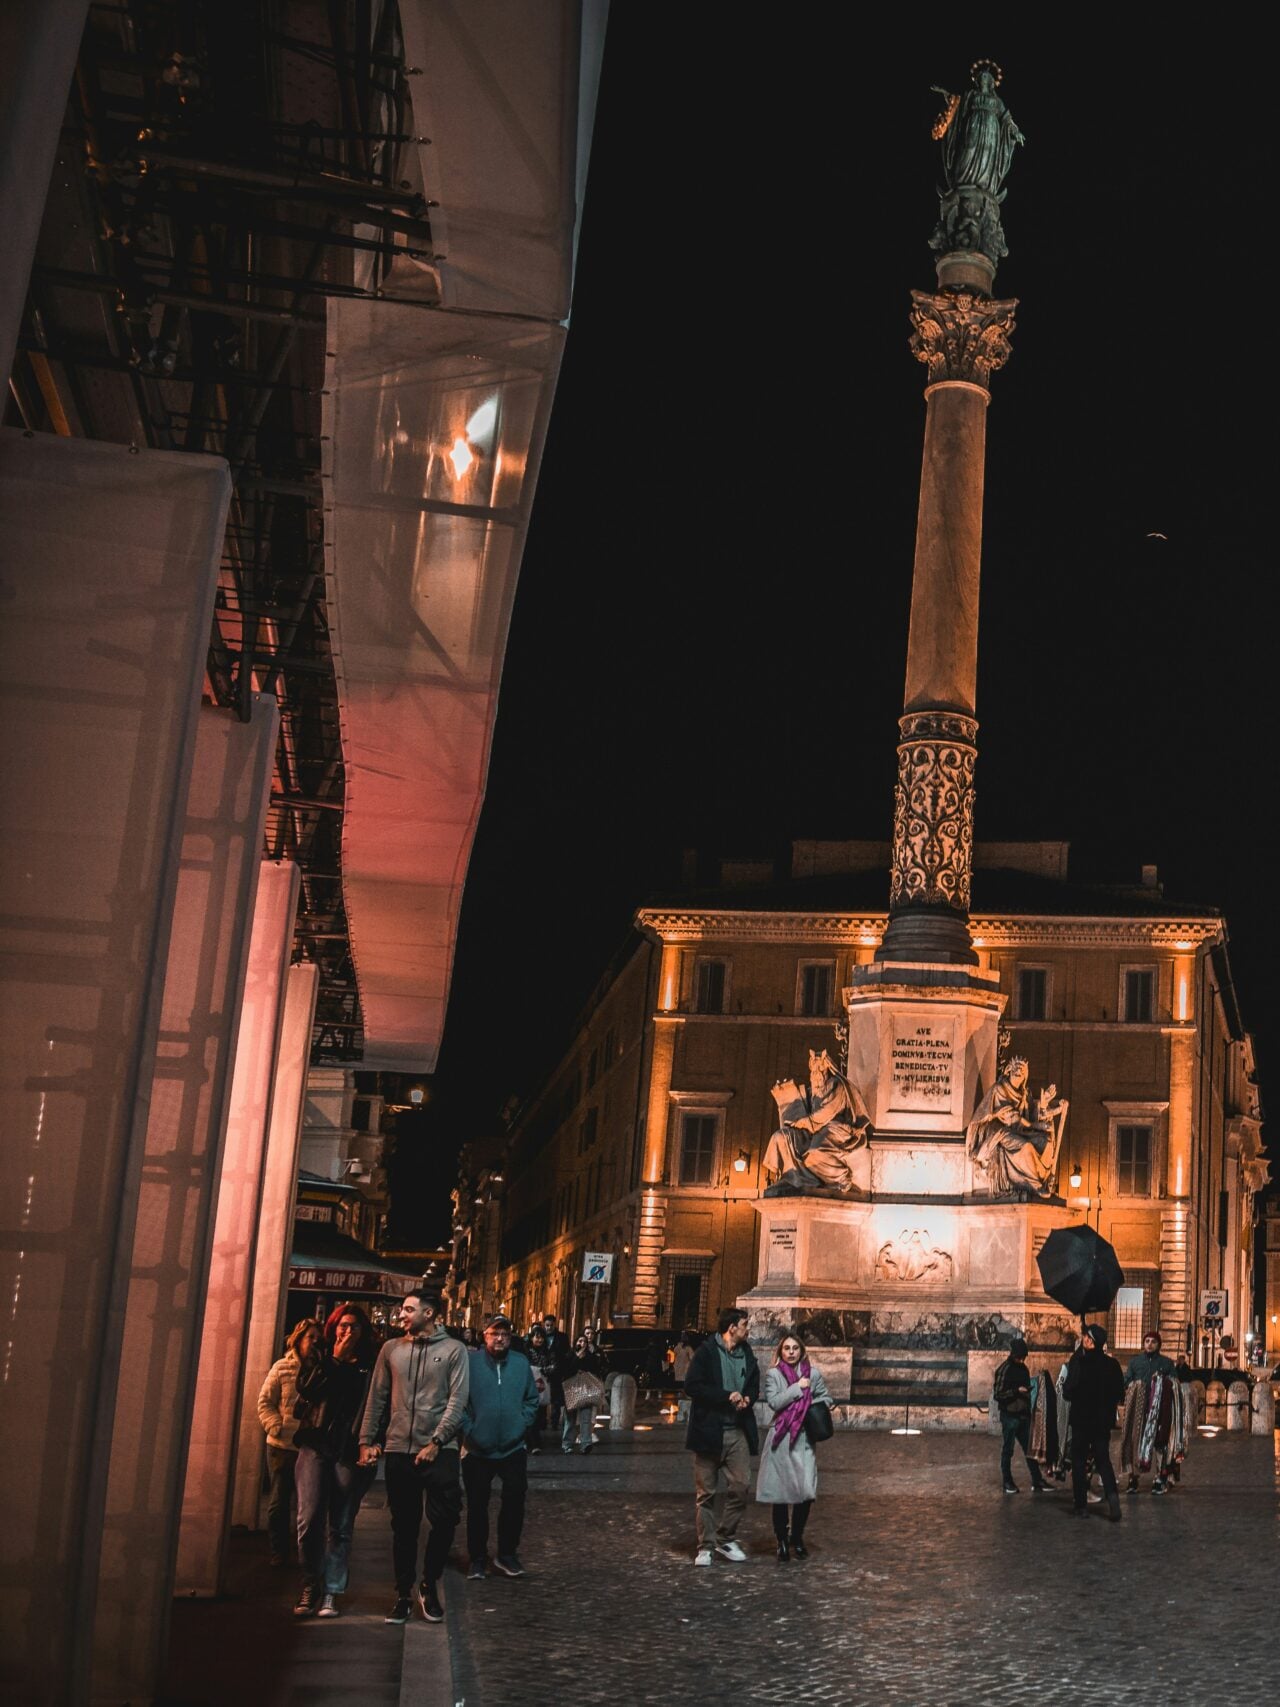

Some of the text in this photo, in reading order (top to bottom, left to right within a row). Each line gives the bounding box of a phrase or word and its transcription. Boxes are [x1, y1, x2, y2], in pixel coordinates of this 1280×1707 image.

[299, 1271, 316, 1285] ON
[325, 1272, 346, 1287] HOP
[348, 1273, 366, 1288] OFF
